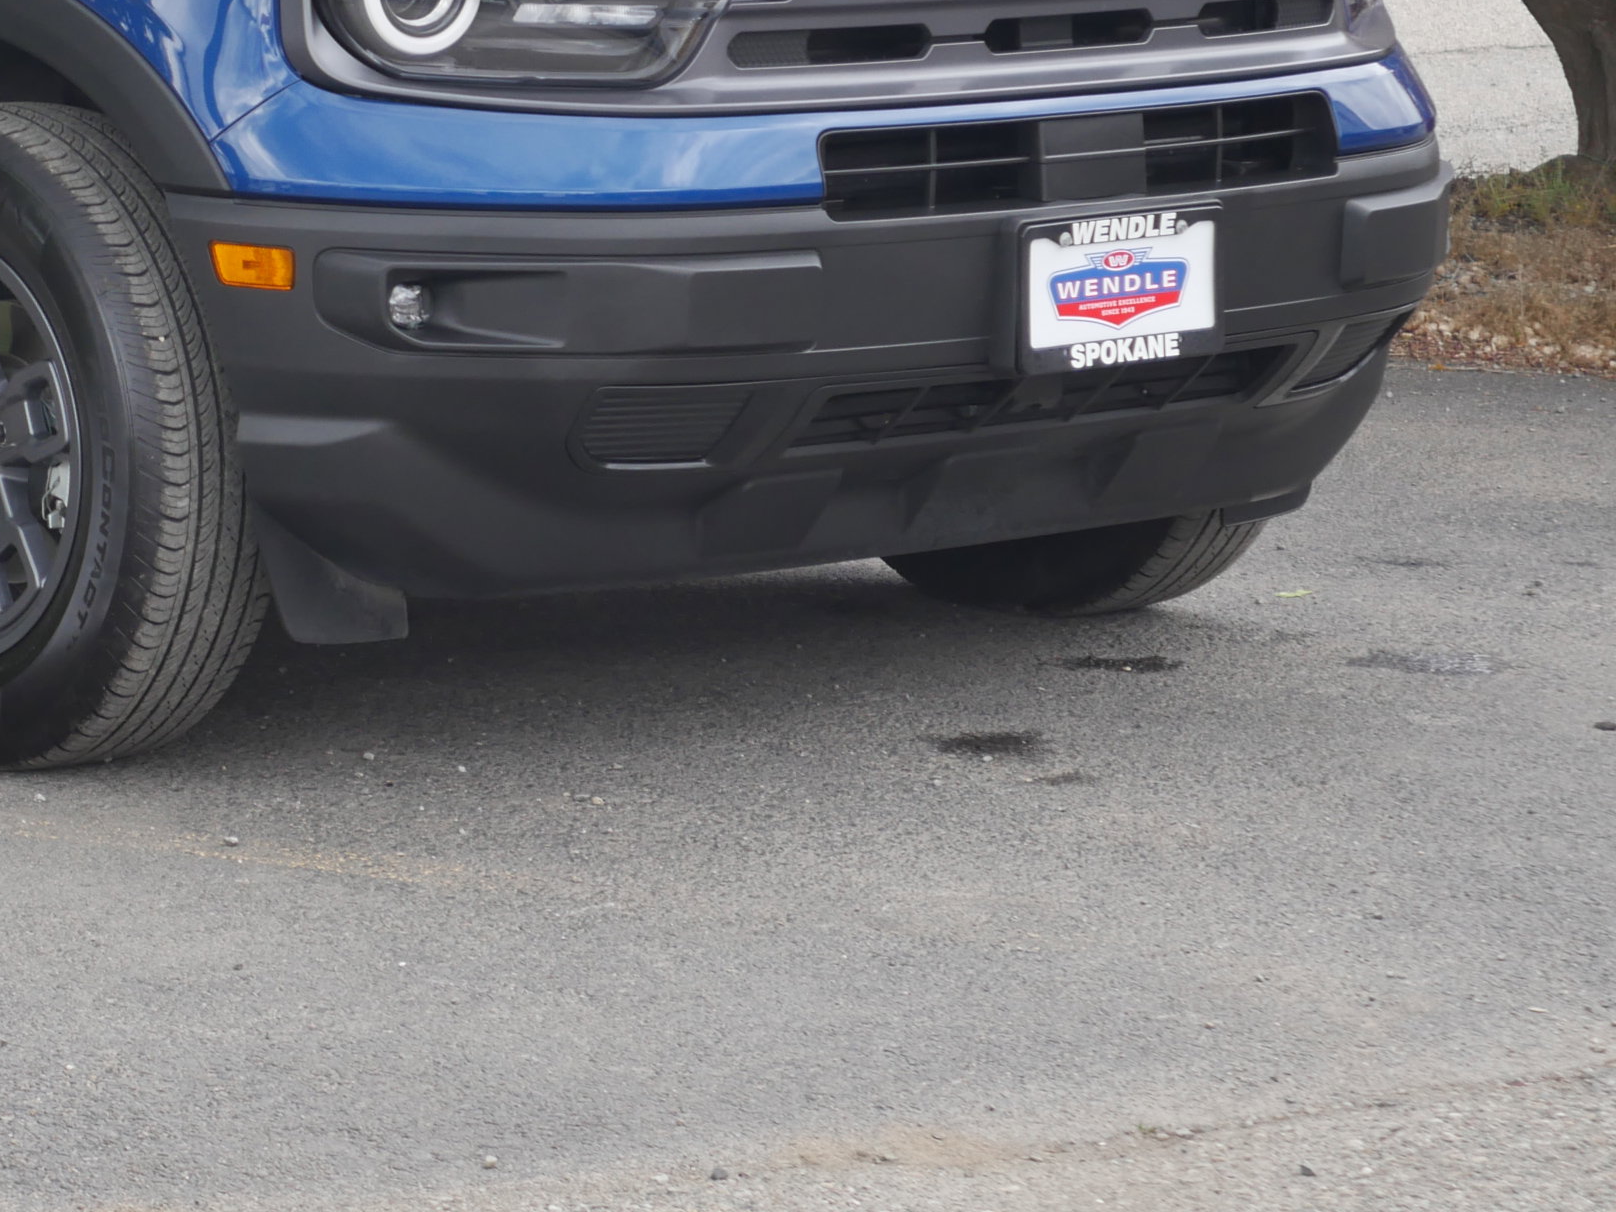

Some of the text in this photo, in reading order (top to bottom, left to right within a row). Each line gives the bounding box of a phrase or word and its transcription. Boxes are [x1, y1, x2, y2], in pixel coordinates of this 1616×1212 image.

[1071, 212, 1177, 245] WENDLE
[1108, 254, 1129, 267] W
[1056, 270, 1177, 299] WENDLE
[1070, 332, 1180, 369] SPOKANE
